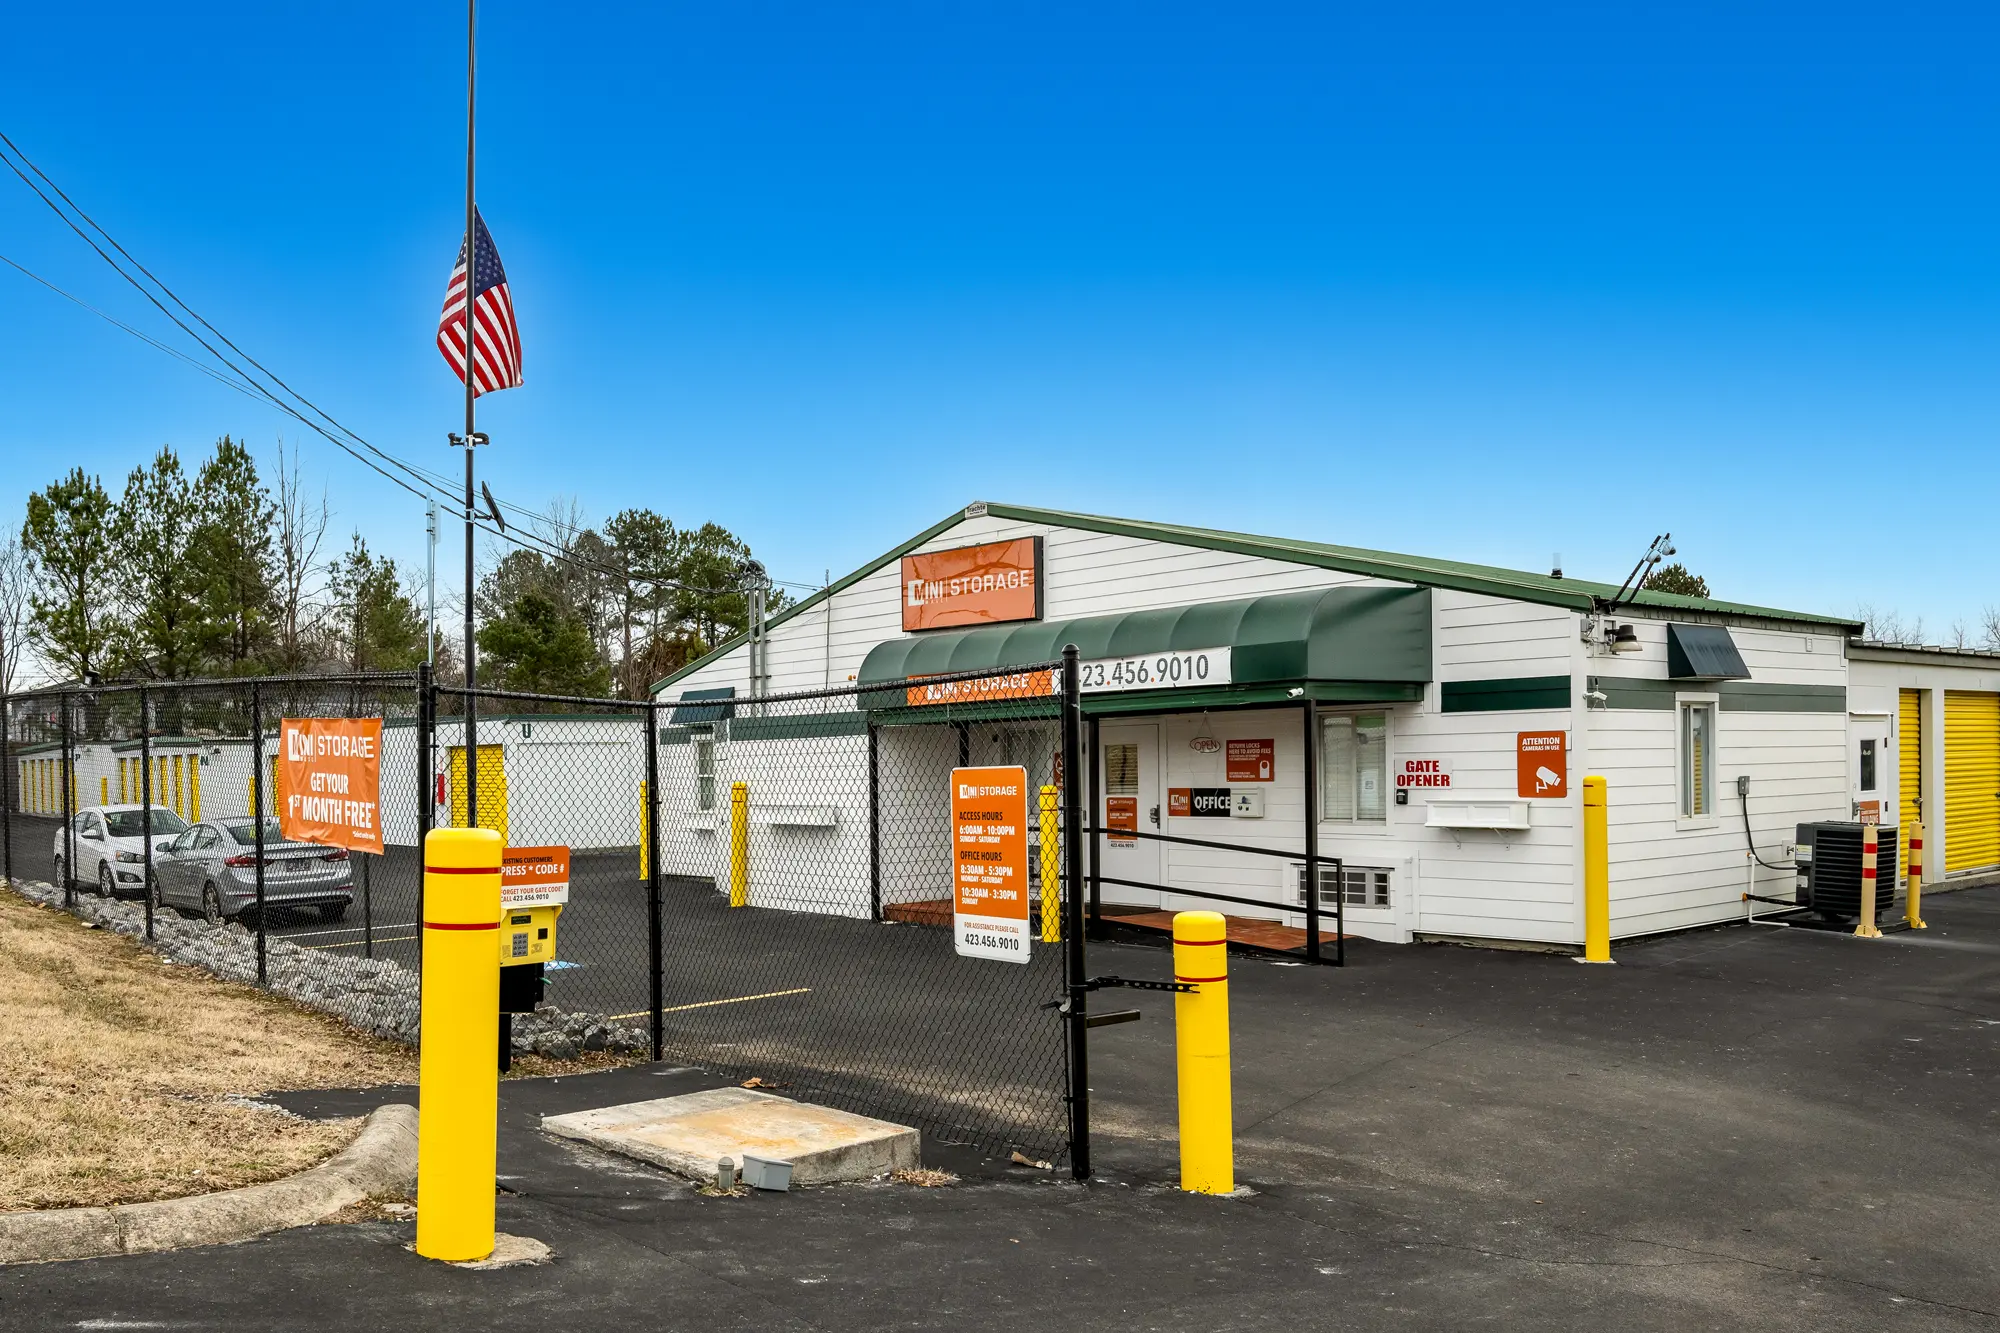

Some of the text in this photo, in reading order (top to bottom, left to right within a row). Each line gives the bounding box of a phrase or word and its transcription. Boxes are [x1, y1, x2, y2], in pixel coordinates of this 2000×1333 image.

[950, 570, 1029, 596] STORAGE
[1079, 655, 1209, 687] 23.456.9010
[963, 673, 1029, 693] STORAGE
[522, 724, 531, 738] U
[317, 735, 374, 758] STORAGE
[1194, 740, 1217, 751] OPEN
[1522, 737, 1560, 746] ATTENTION
[1405, 760, 1440, 773] GATE
[311, 772, 349, 794] GET YOUR
[1396, 774, 1450, 787] OPENER
[979, 785, 1017, 796] STORAGE
[1194, 796, 1231, 809] OFFICE
[302, 796, 342, 825] MONTH
[959, 811, 1003, 820] ACCESS HOURS
[959, 825, 983, 835] 6:00AM
[987, 825, 1015, 835] 10:00PM
[959, 835, 976, 843] SUNDAY
[960, 851, 1002, 861] OFFICE HOURS
[535, 864, 558, 875] CODE
[960, 864, 984, 875] 8:30AM
[988, 866, 1013, 876] 5:30PM
[981, 876, 1003, 884] SATURDAY
[512, 893, 550, 901] 423.456.9010
[961, 887, 989, 898] 10:30AM
[992, 889, 1017, 900] 3:30PM
[961, 897, 978, 905] SUNDAY
[964, 921, 1019, 934] FOR ASSISTANCE PLEASE CALL
[964, 933, 1019, 951] 423.456.9010
